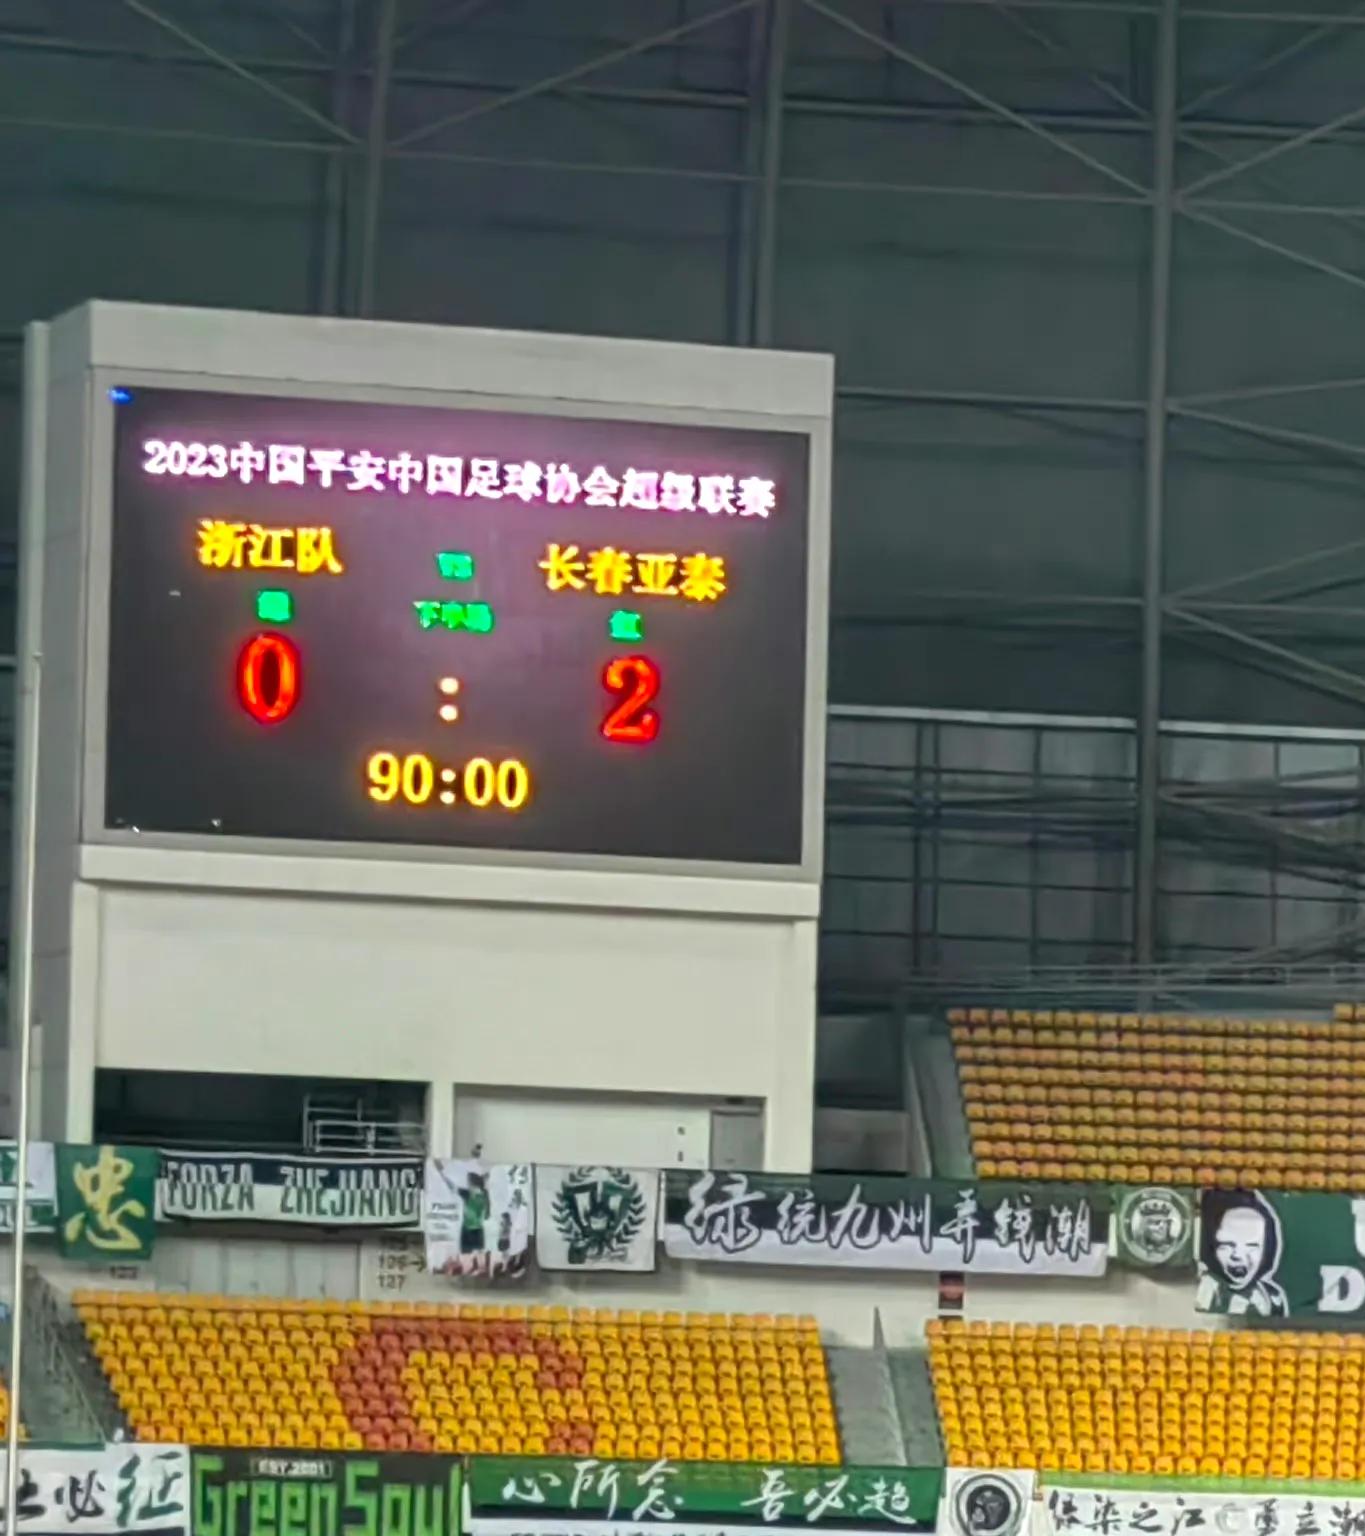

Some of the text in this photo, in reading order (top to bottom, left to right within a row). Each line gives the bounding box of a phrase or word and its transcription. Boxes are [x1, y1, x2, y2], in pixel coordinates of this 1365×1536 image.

[143, 440, 776, 519] 2023中国平安中国足球协会超级联赛
[197, 518, 344, 574] 浙江队
[537, 543, 727, 602] 长春亚泰
[238, 632, 299, 723] 0
[600, 655, 661, 743] 2
[366, 752, 529, 810] 90:00
[65, 1146, 146, 1250] 忠
[166, 1161, 418, 1217] FORZA ZHEJIANG
